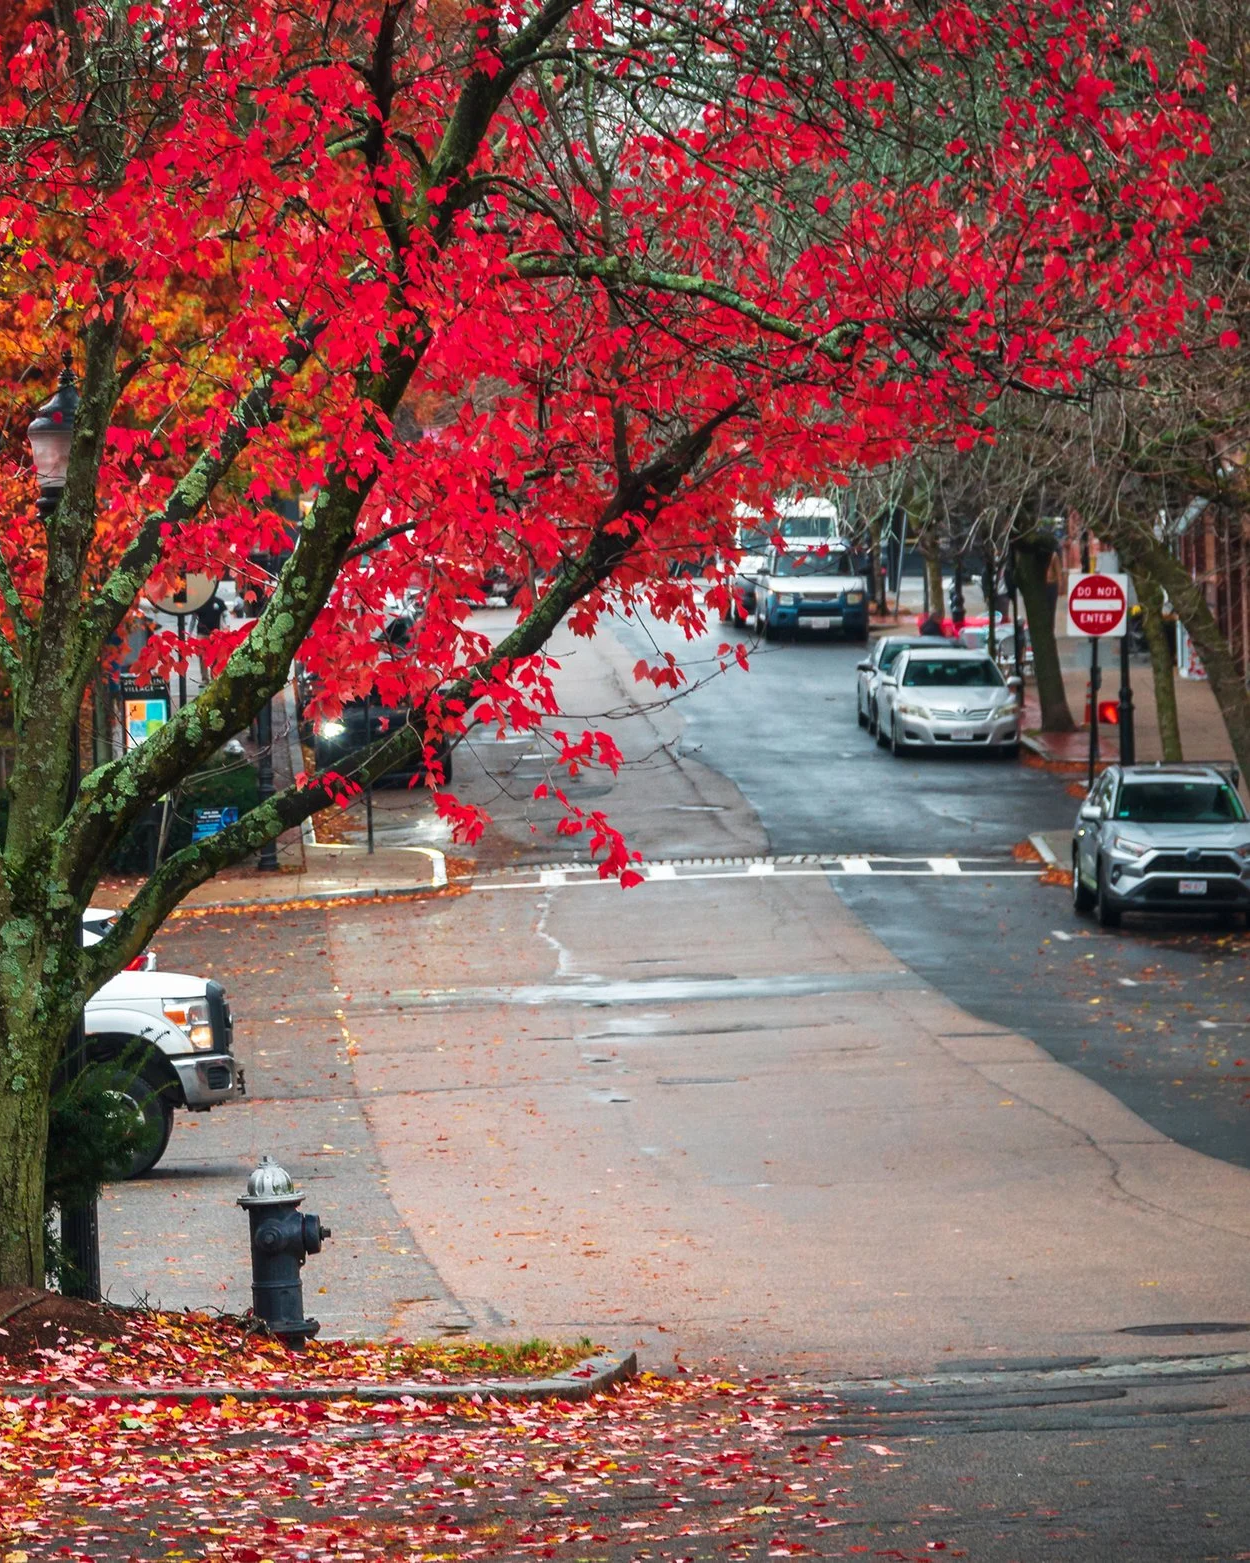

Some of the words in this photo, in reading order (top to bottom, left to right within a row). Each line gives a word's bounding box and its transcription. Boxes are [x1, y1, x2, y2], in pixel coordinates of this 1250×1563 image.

[1077, 587, 1091, 597] DO
[1097, 587, 1117, 597] NOT
[1080, 613, 1113, 624] ENTER
